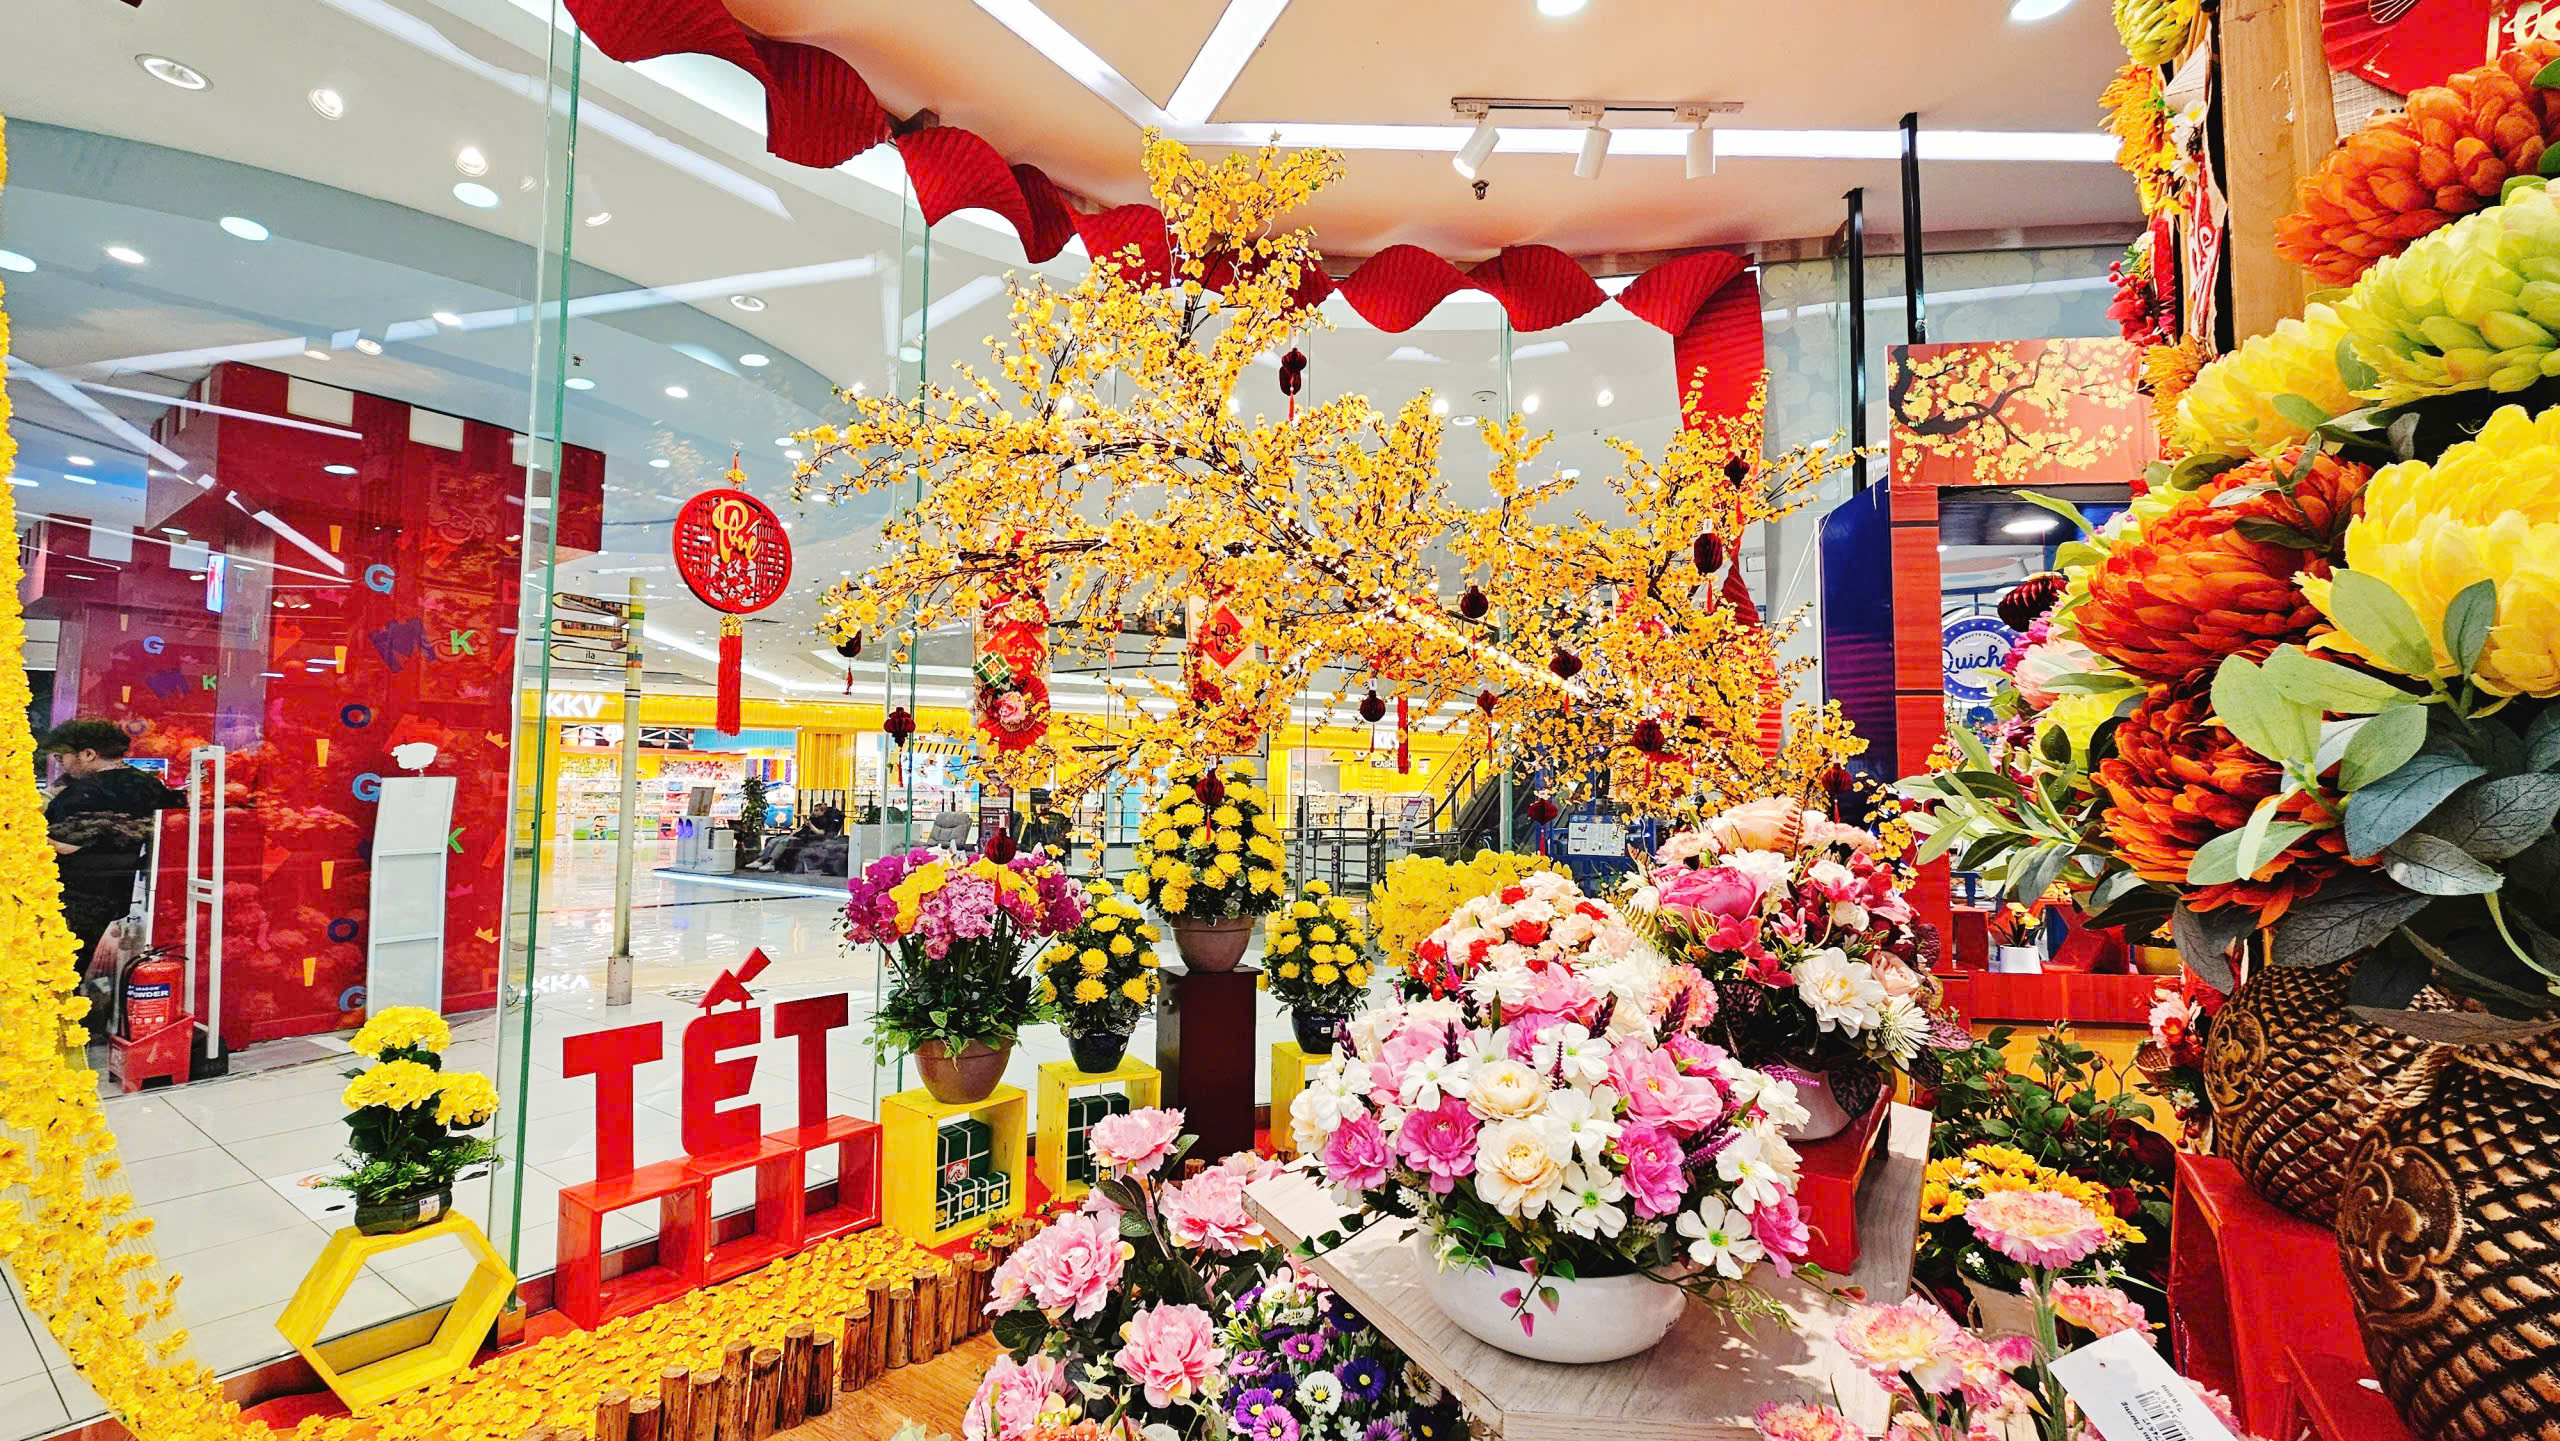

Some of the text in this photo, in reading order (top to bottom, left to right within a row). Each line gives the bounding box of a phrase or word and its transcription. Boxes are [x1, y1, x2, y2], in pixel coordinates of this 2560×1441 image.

[585, 650, 596, 660] ila
[1943, 645, 2006, 674] Quich
[546, 692, 604, 717] KKV
[1374, 760, 1397, 768] CASHI
